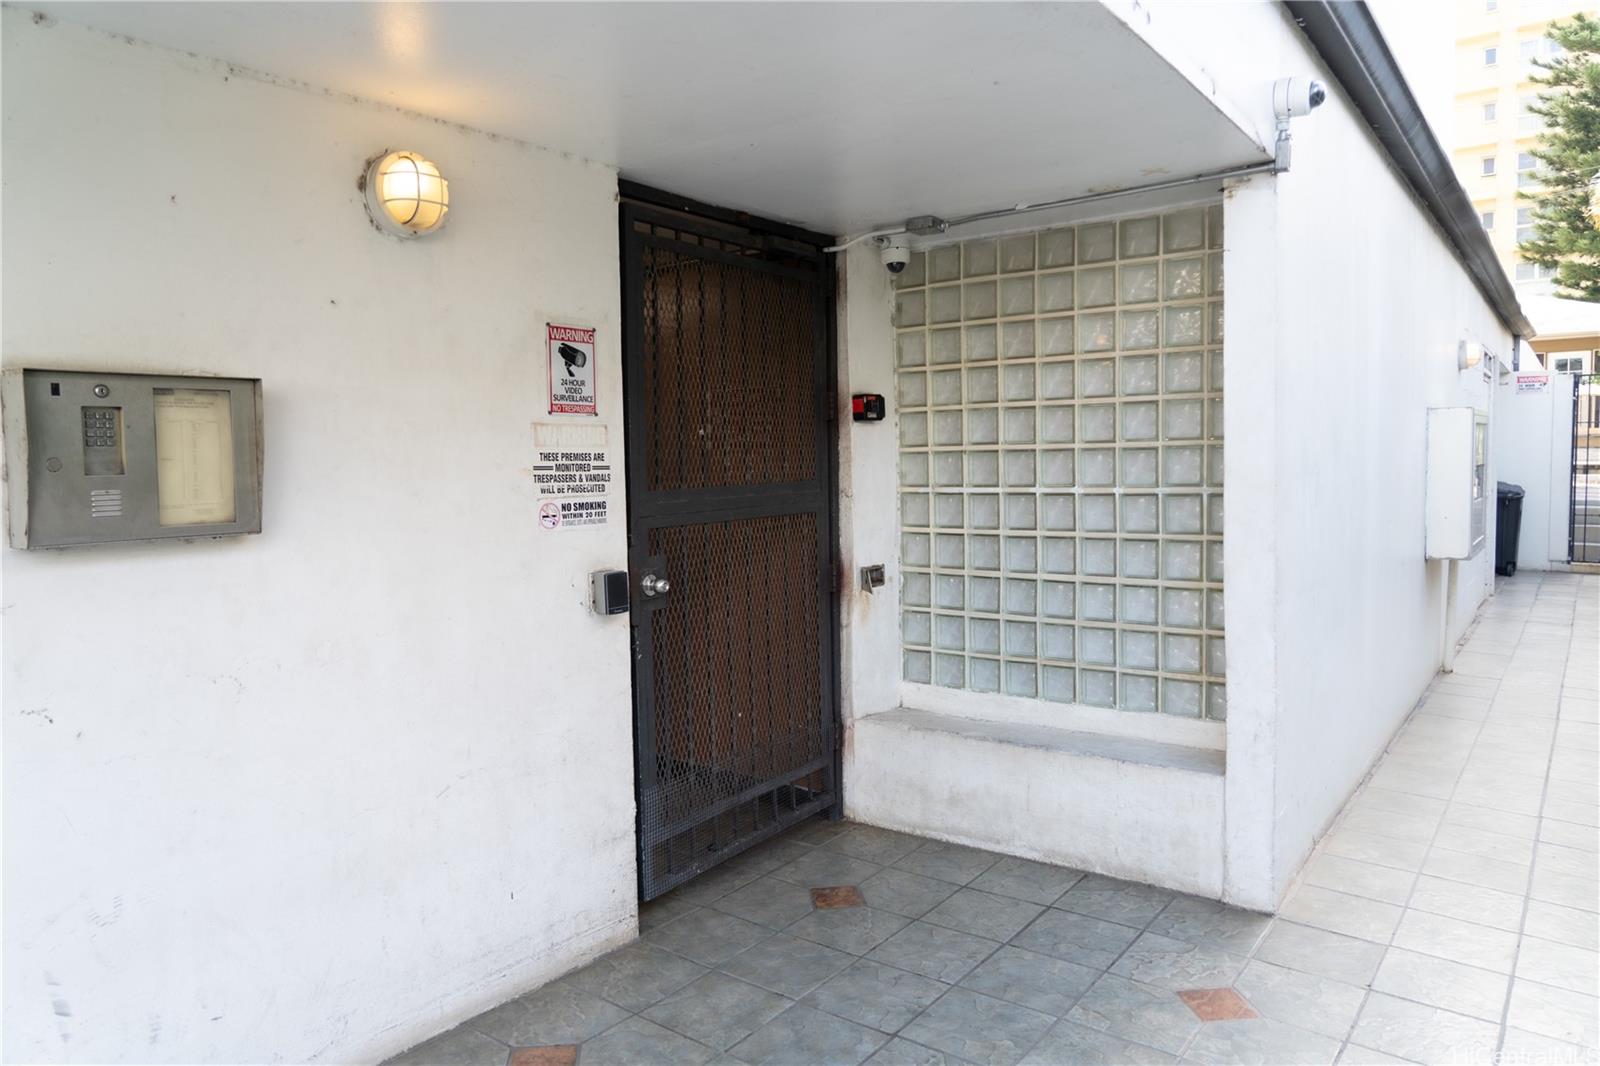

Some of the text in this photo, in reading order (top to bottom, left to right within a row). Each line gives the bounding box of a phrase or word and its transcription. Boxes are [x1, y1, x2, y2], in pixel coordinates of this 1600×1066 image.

[550, 328, 594, 342] WARNING
[553, 394, 593, 403] SURVEILLANCE
[562, 406, 595, 414] TRESPASSING
[539, 453, 605, 462] THESE PREMISES ARE
[554, 464, 591, 472] MONITORED
[534, 475, 576, 483] TRESPASSERS
[585, 474, 611, 482] VANDALS
[540, 485, 555, 494] WILL
[557, 485, 565, 493] BE
[561, 501, 607, 512] NO SMOKING
